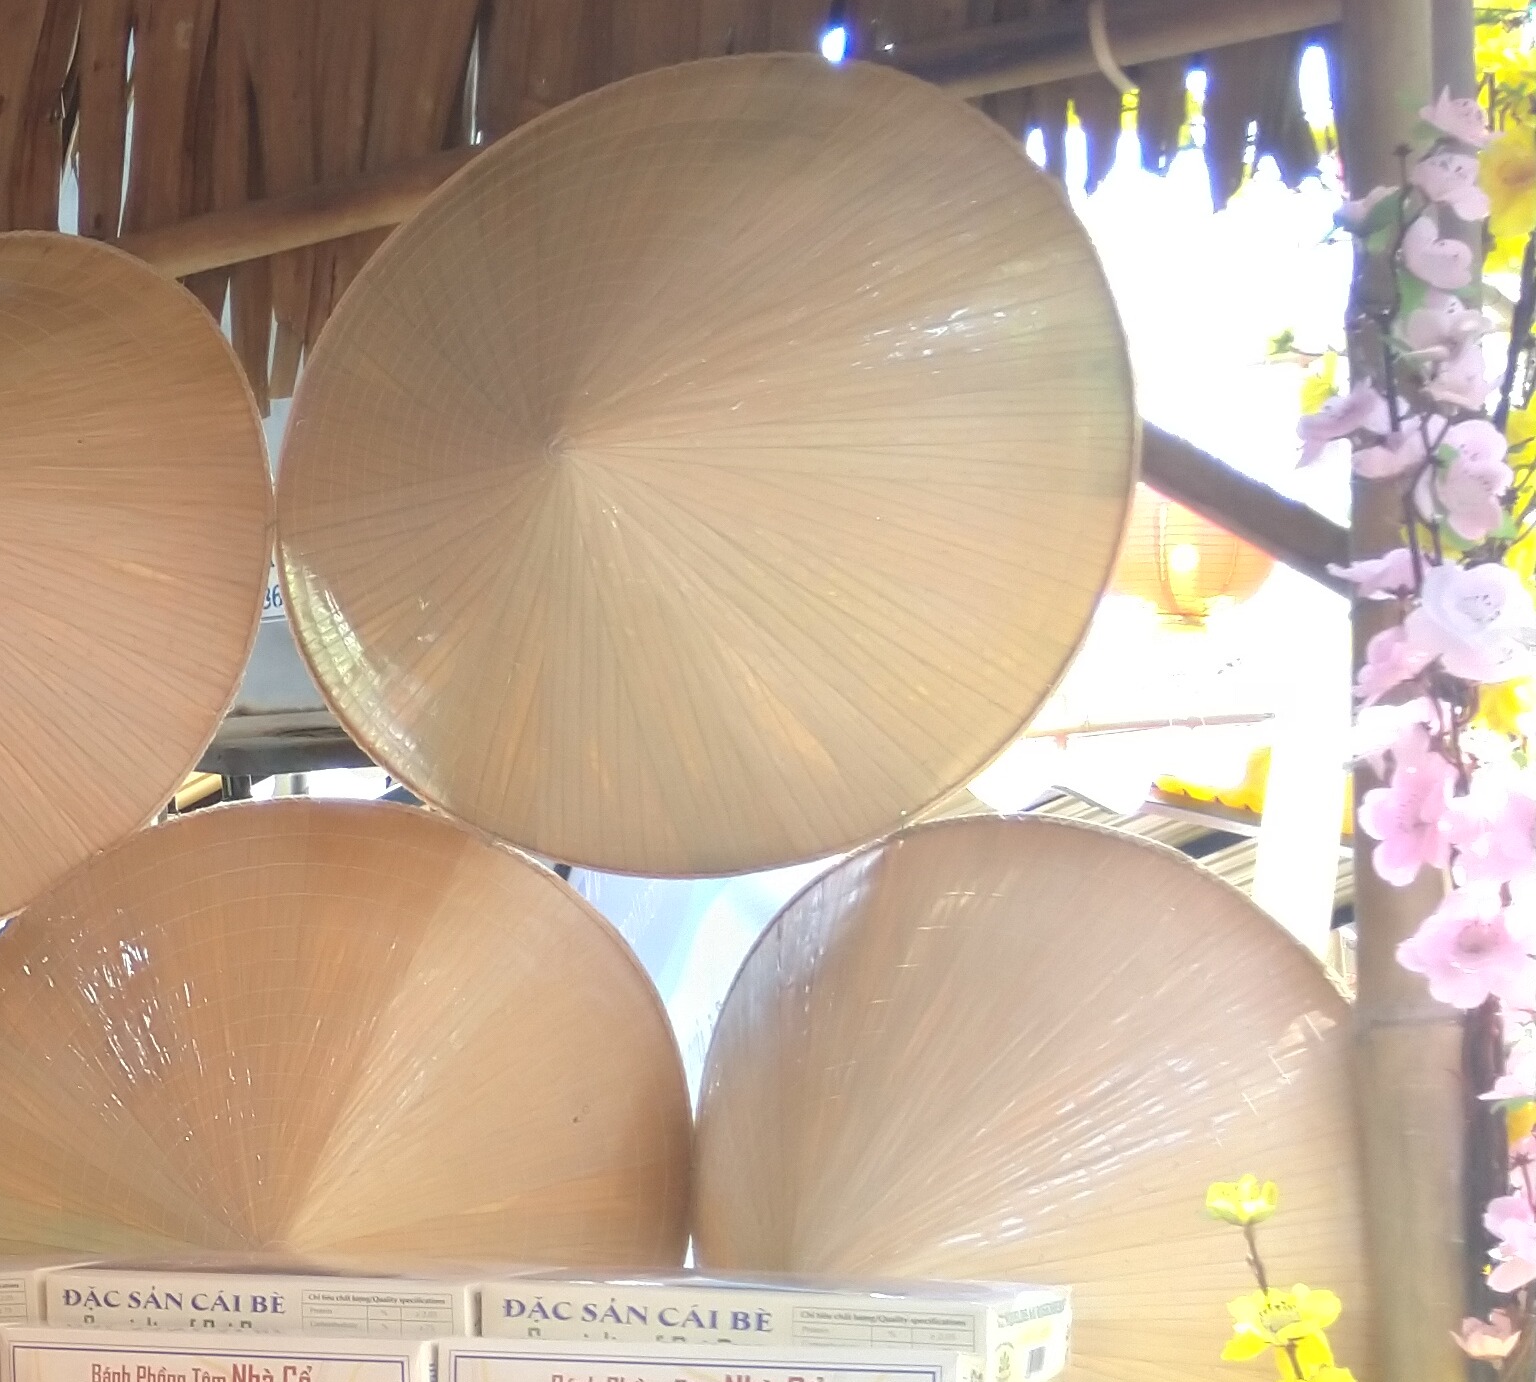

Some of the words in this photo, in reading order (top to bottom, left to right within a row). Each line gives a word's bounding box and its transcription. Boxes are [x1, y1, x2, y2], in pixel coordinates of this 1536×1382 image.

[63, 1286, 121, 1311] ĐẶC
[129, 1286, 183, 1311] SẢN
[191, 1288, 241, 1313] CÁI
[250, 1291, 286, 1314] BÈ
[503, 1297, 574, 1324] ĐẶC
[580, 1298, 649, 1326] SẢN
[658, 1301, 719, 1330] CÁI
[730, 1306, 774, 1332] BÈ
